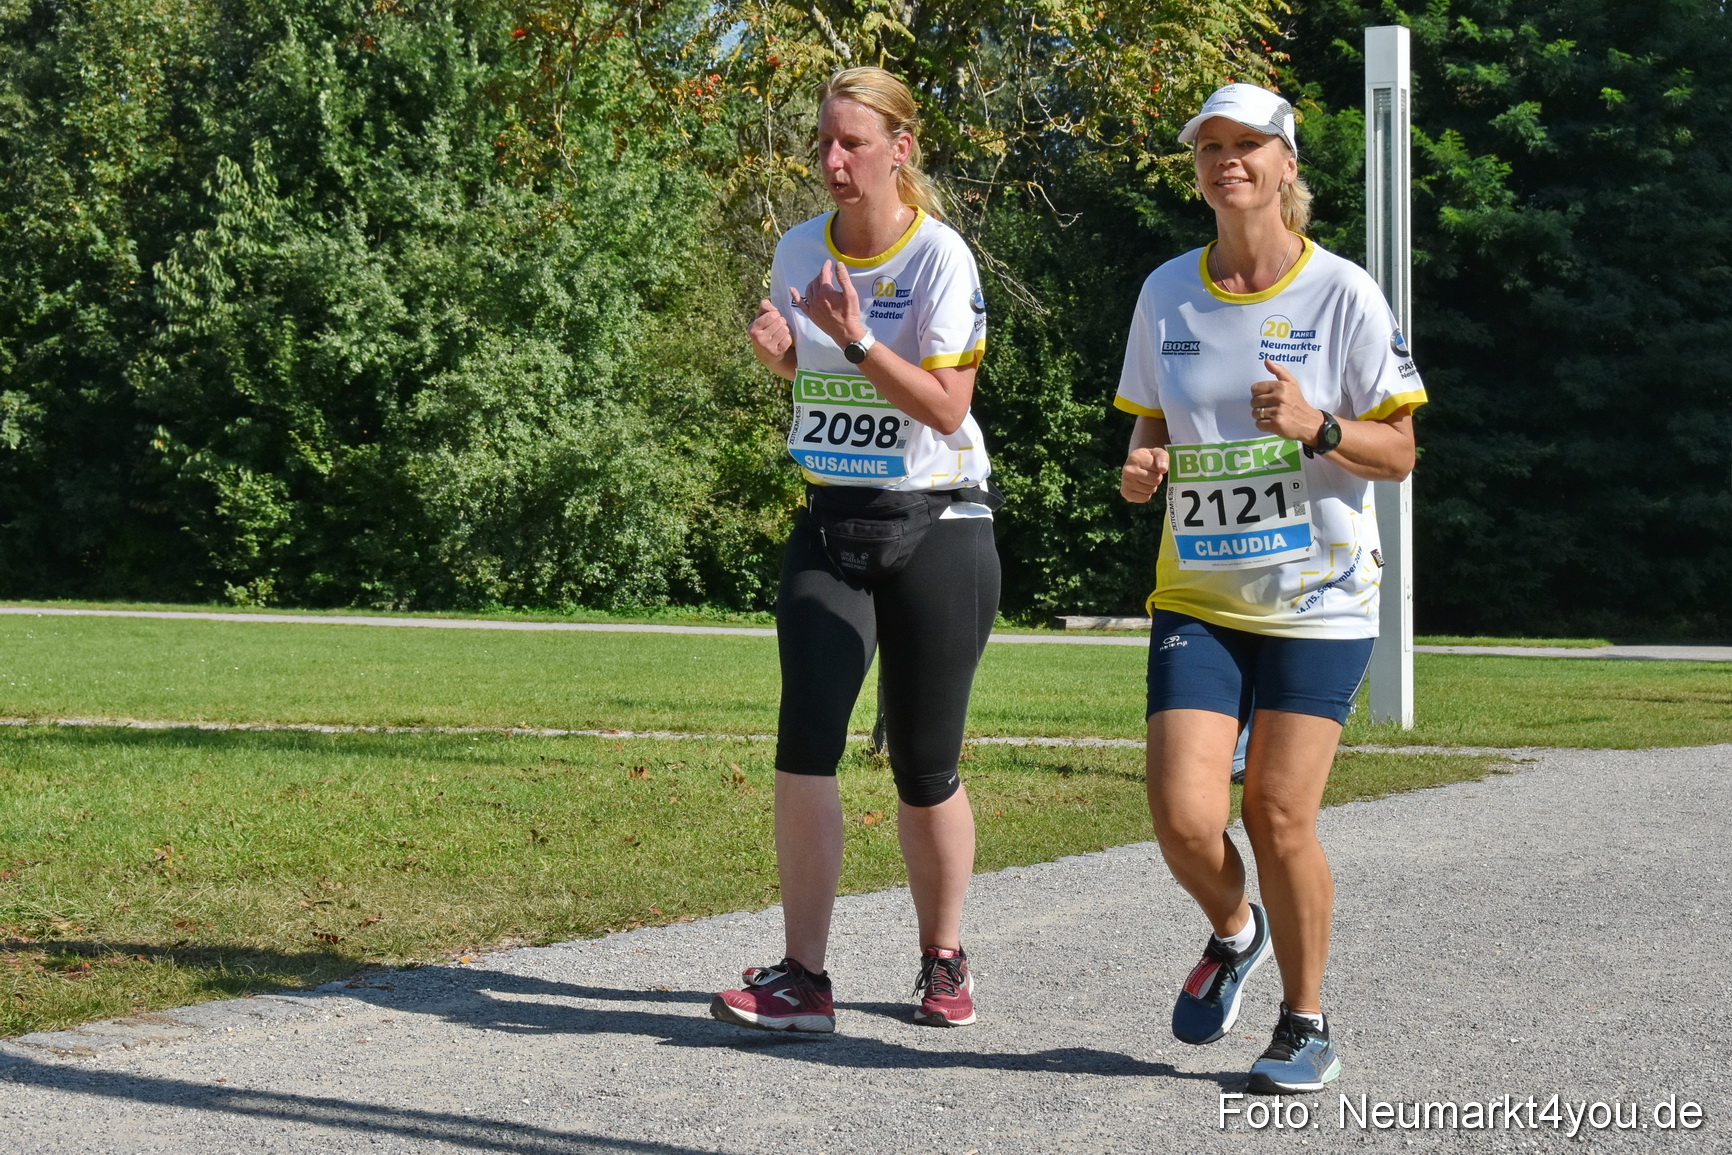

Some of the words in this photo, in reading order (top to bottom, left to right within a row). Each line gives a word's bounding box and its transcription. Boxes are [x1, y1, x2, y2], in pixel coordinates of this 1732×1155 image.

[874, 282, 896, 297] 20
[1263, 320, 1290, 338] 20
[1162, 341, 1201, 351] BOCK
[1260, 340, 1322, 351] Neumarkter
[1258, 352, 1309, 364] Stadtlauf
[803, 376, 890, 402] BOC
[803, 410, 901, 449] 2098
[903, 419, 910, 427] D
[804, 455, 889, 475] SUSANNE
[1177, 442, 1287, 476] BOCK
[1181, 481, 1287, 527] 2121
[1292, 482, 1300, 490] D
[1194, 533, 1288, 556] CLAUDIA
